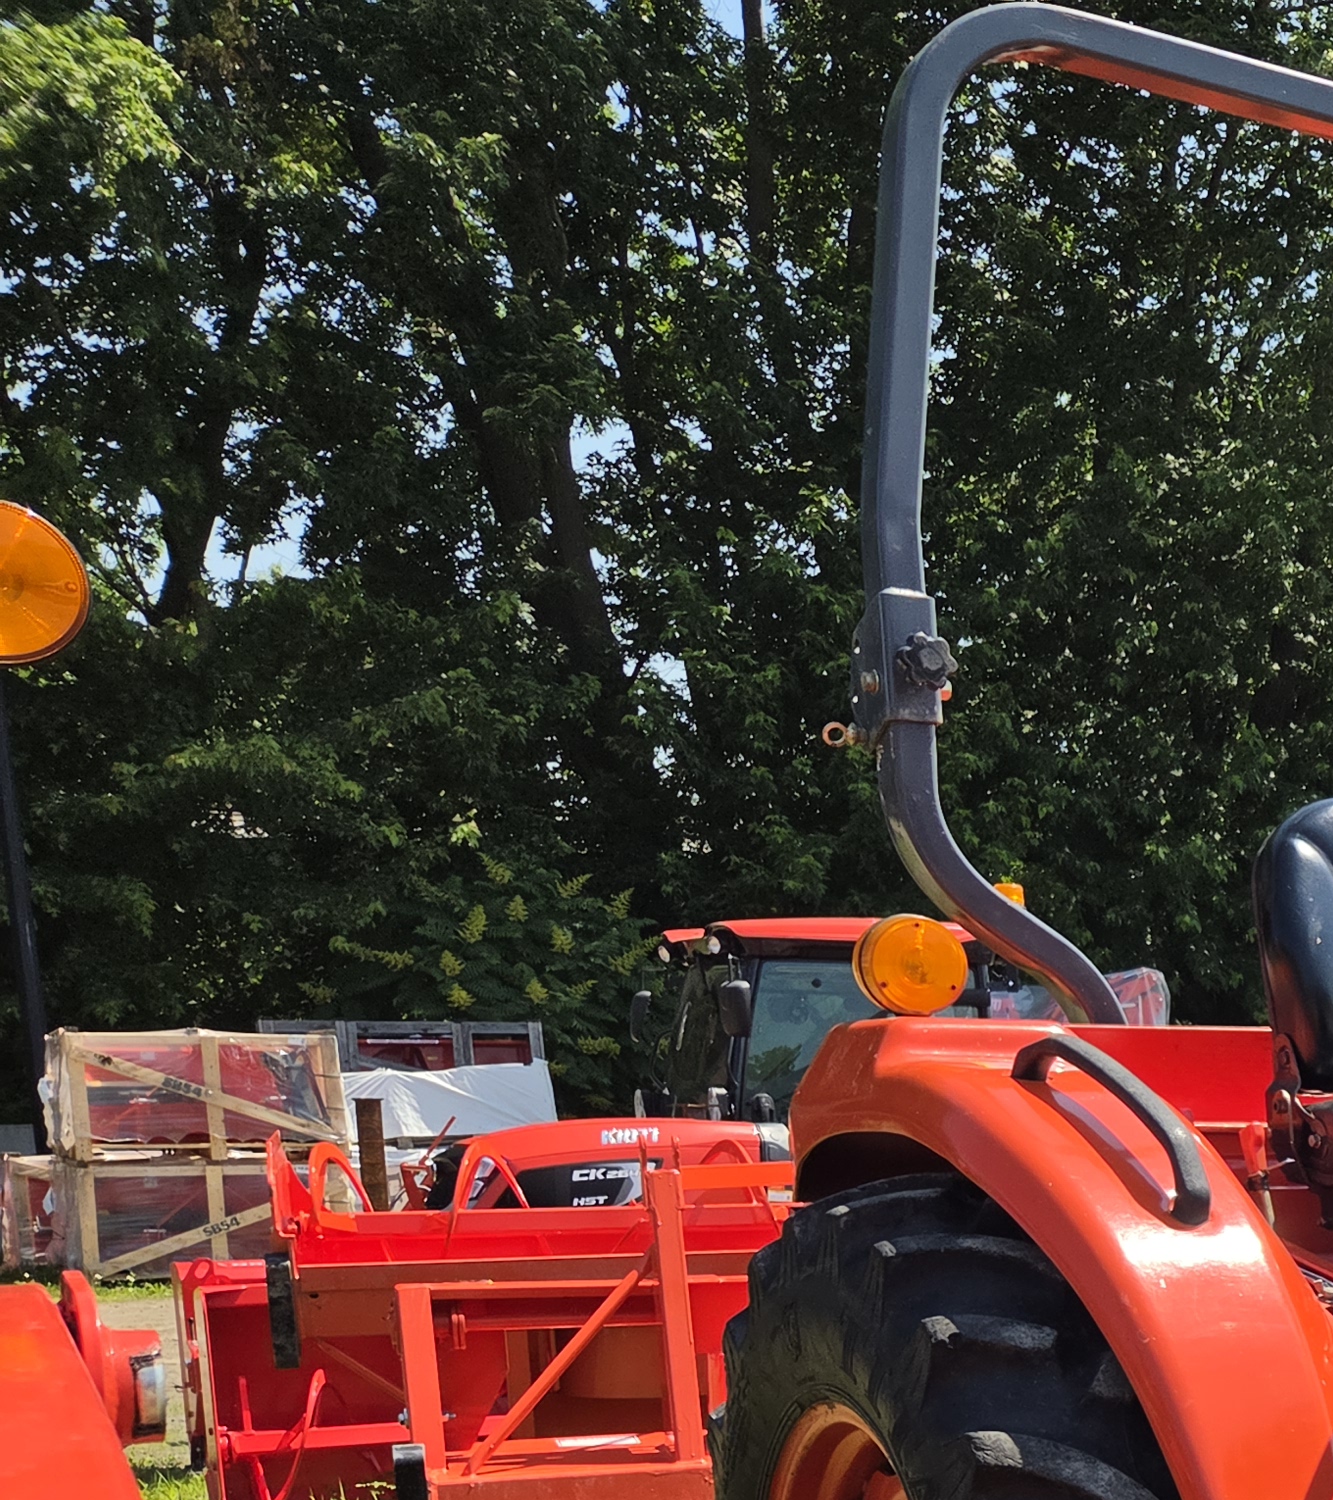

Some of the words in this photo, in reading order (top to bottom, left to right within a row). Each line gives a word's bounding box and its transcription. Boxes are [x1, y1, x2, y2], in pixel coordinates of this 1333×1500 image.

[161, 1077, 203, 1098] SB54
[572, 1195, 609, 1206] HST
[202, 1216, 241, 1237] SB54
